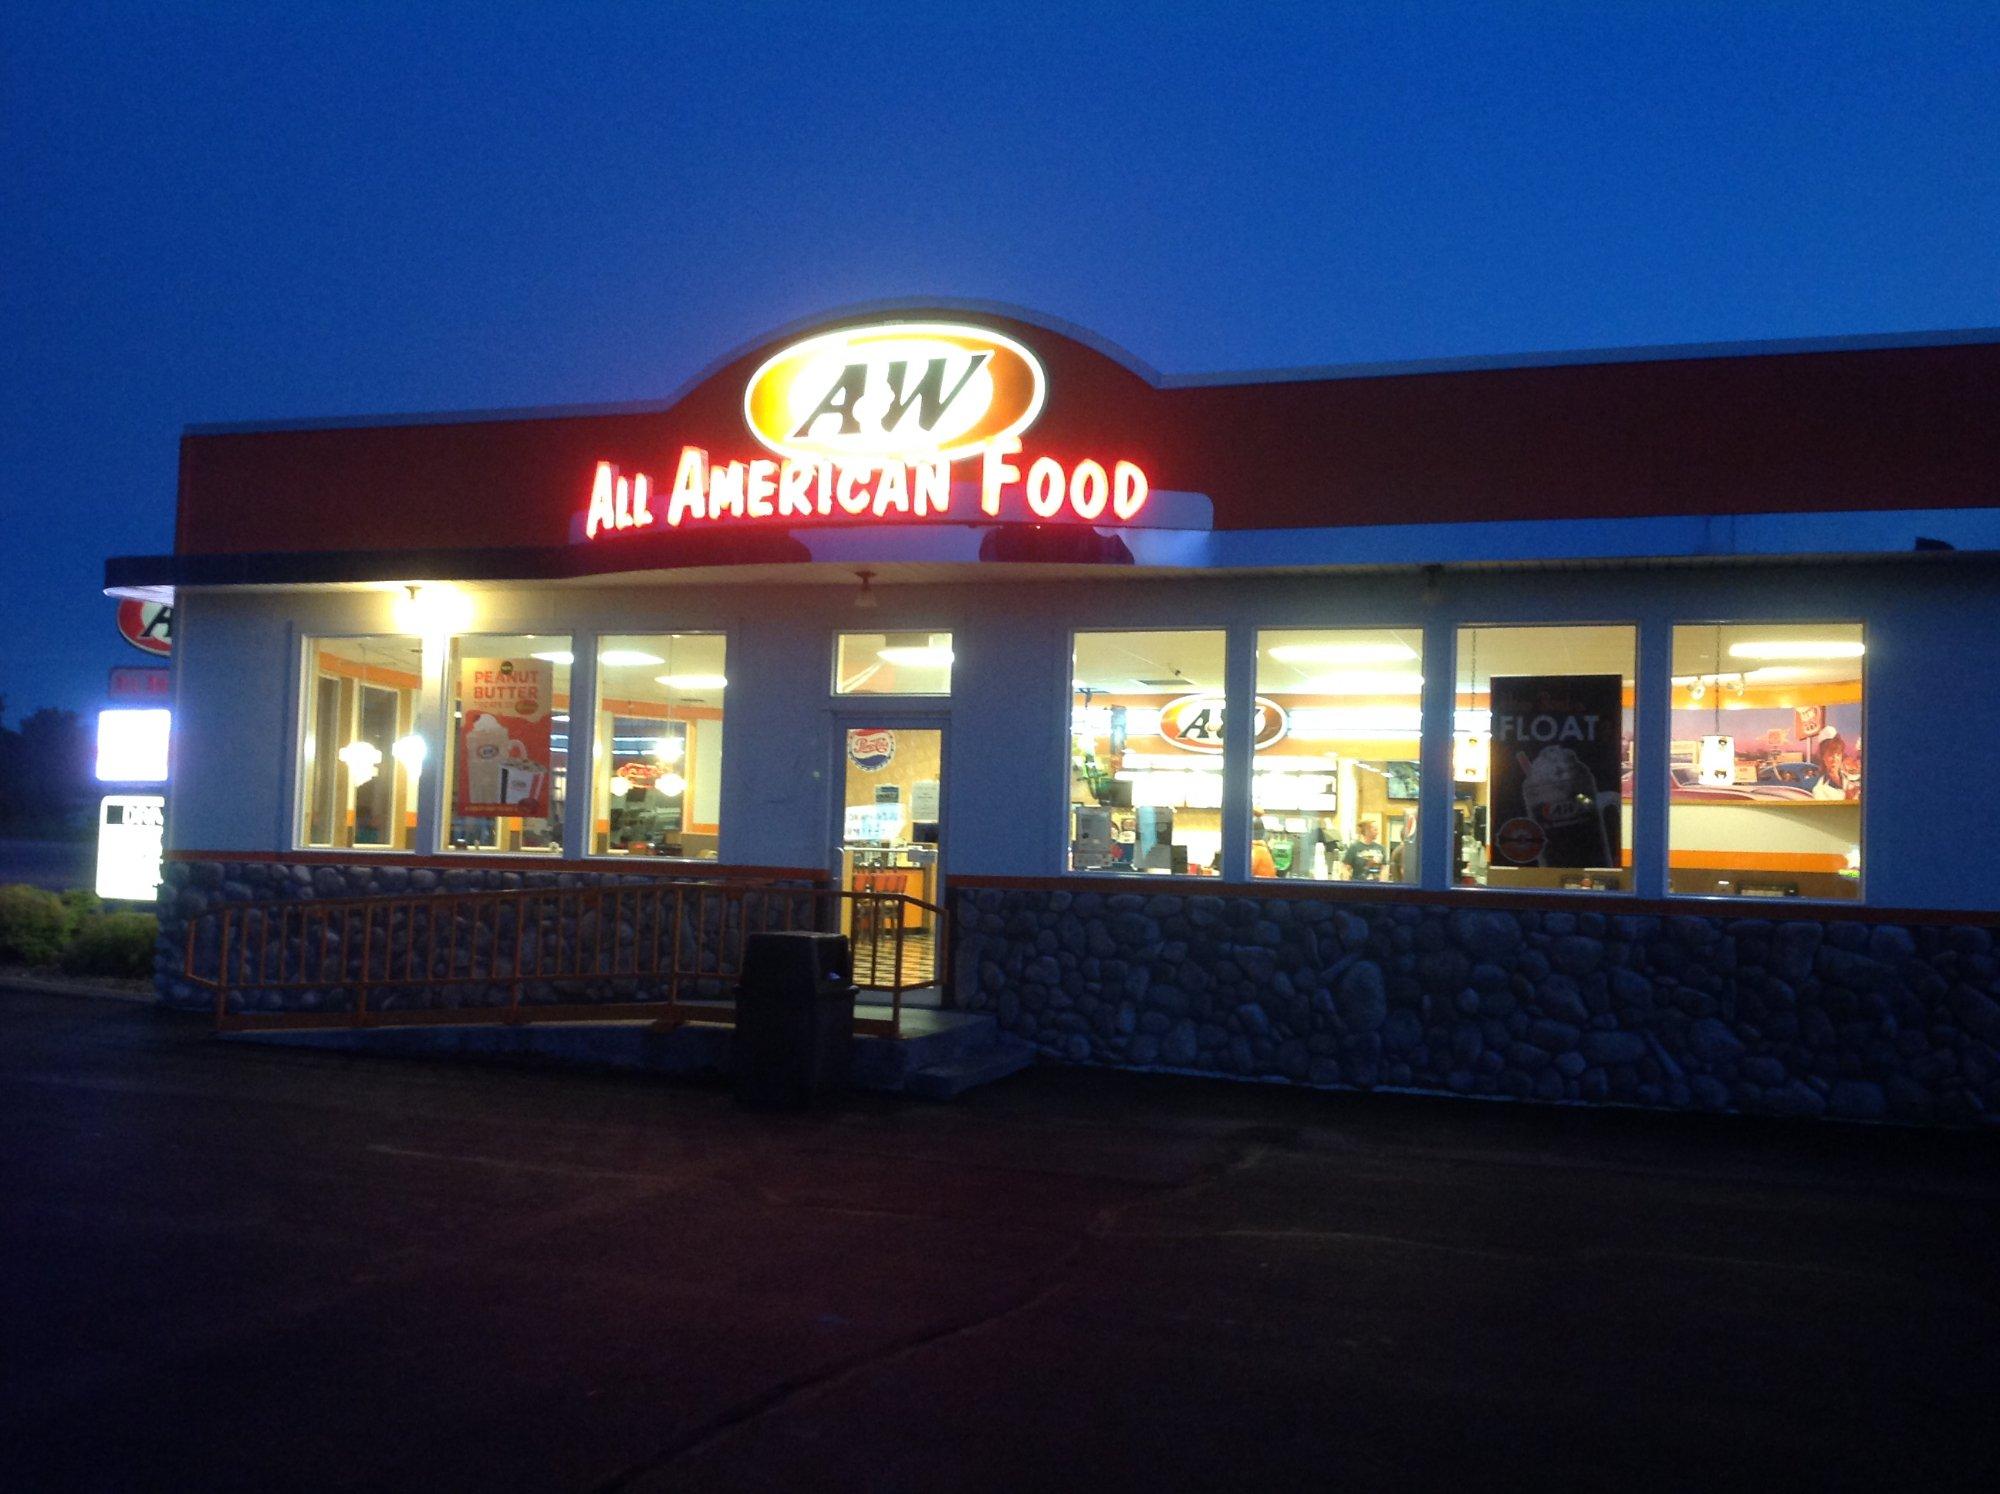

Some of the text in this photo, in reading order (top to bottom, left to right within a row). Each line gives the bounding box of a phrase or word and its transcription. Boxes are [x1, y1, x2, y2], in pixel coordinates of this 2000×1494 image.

[667, 445, 951, 526] AMERICAN
[980, 436, 1149, 520] FOOD
[474, 671, 537, 684] PEANUT
[473, 686, 538, 699] BUTTER
[1499, 714, 1600, 742] FLOAT
